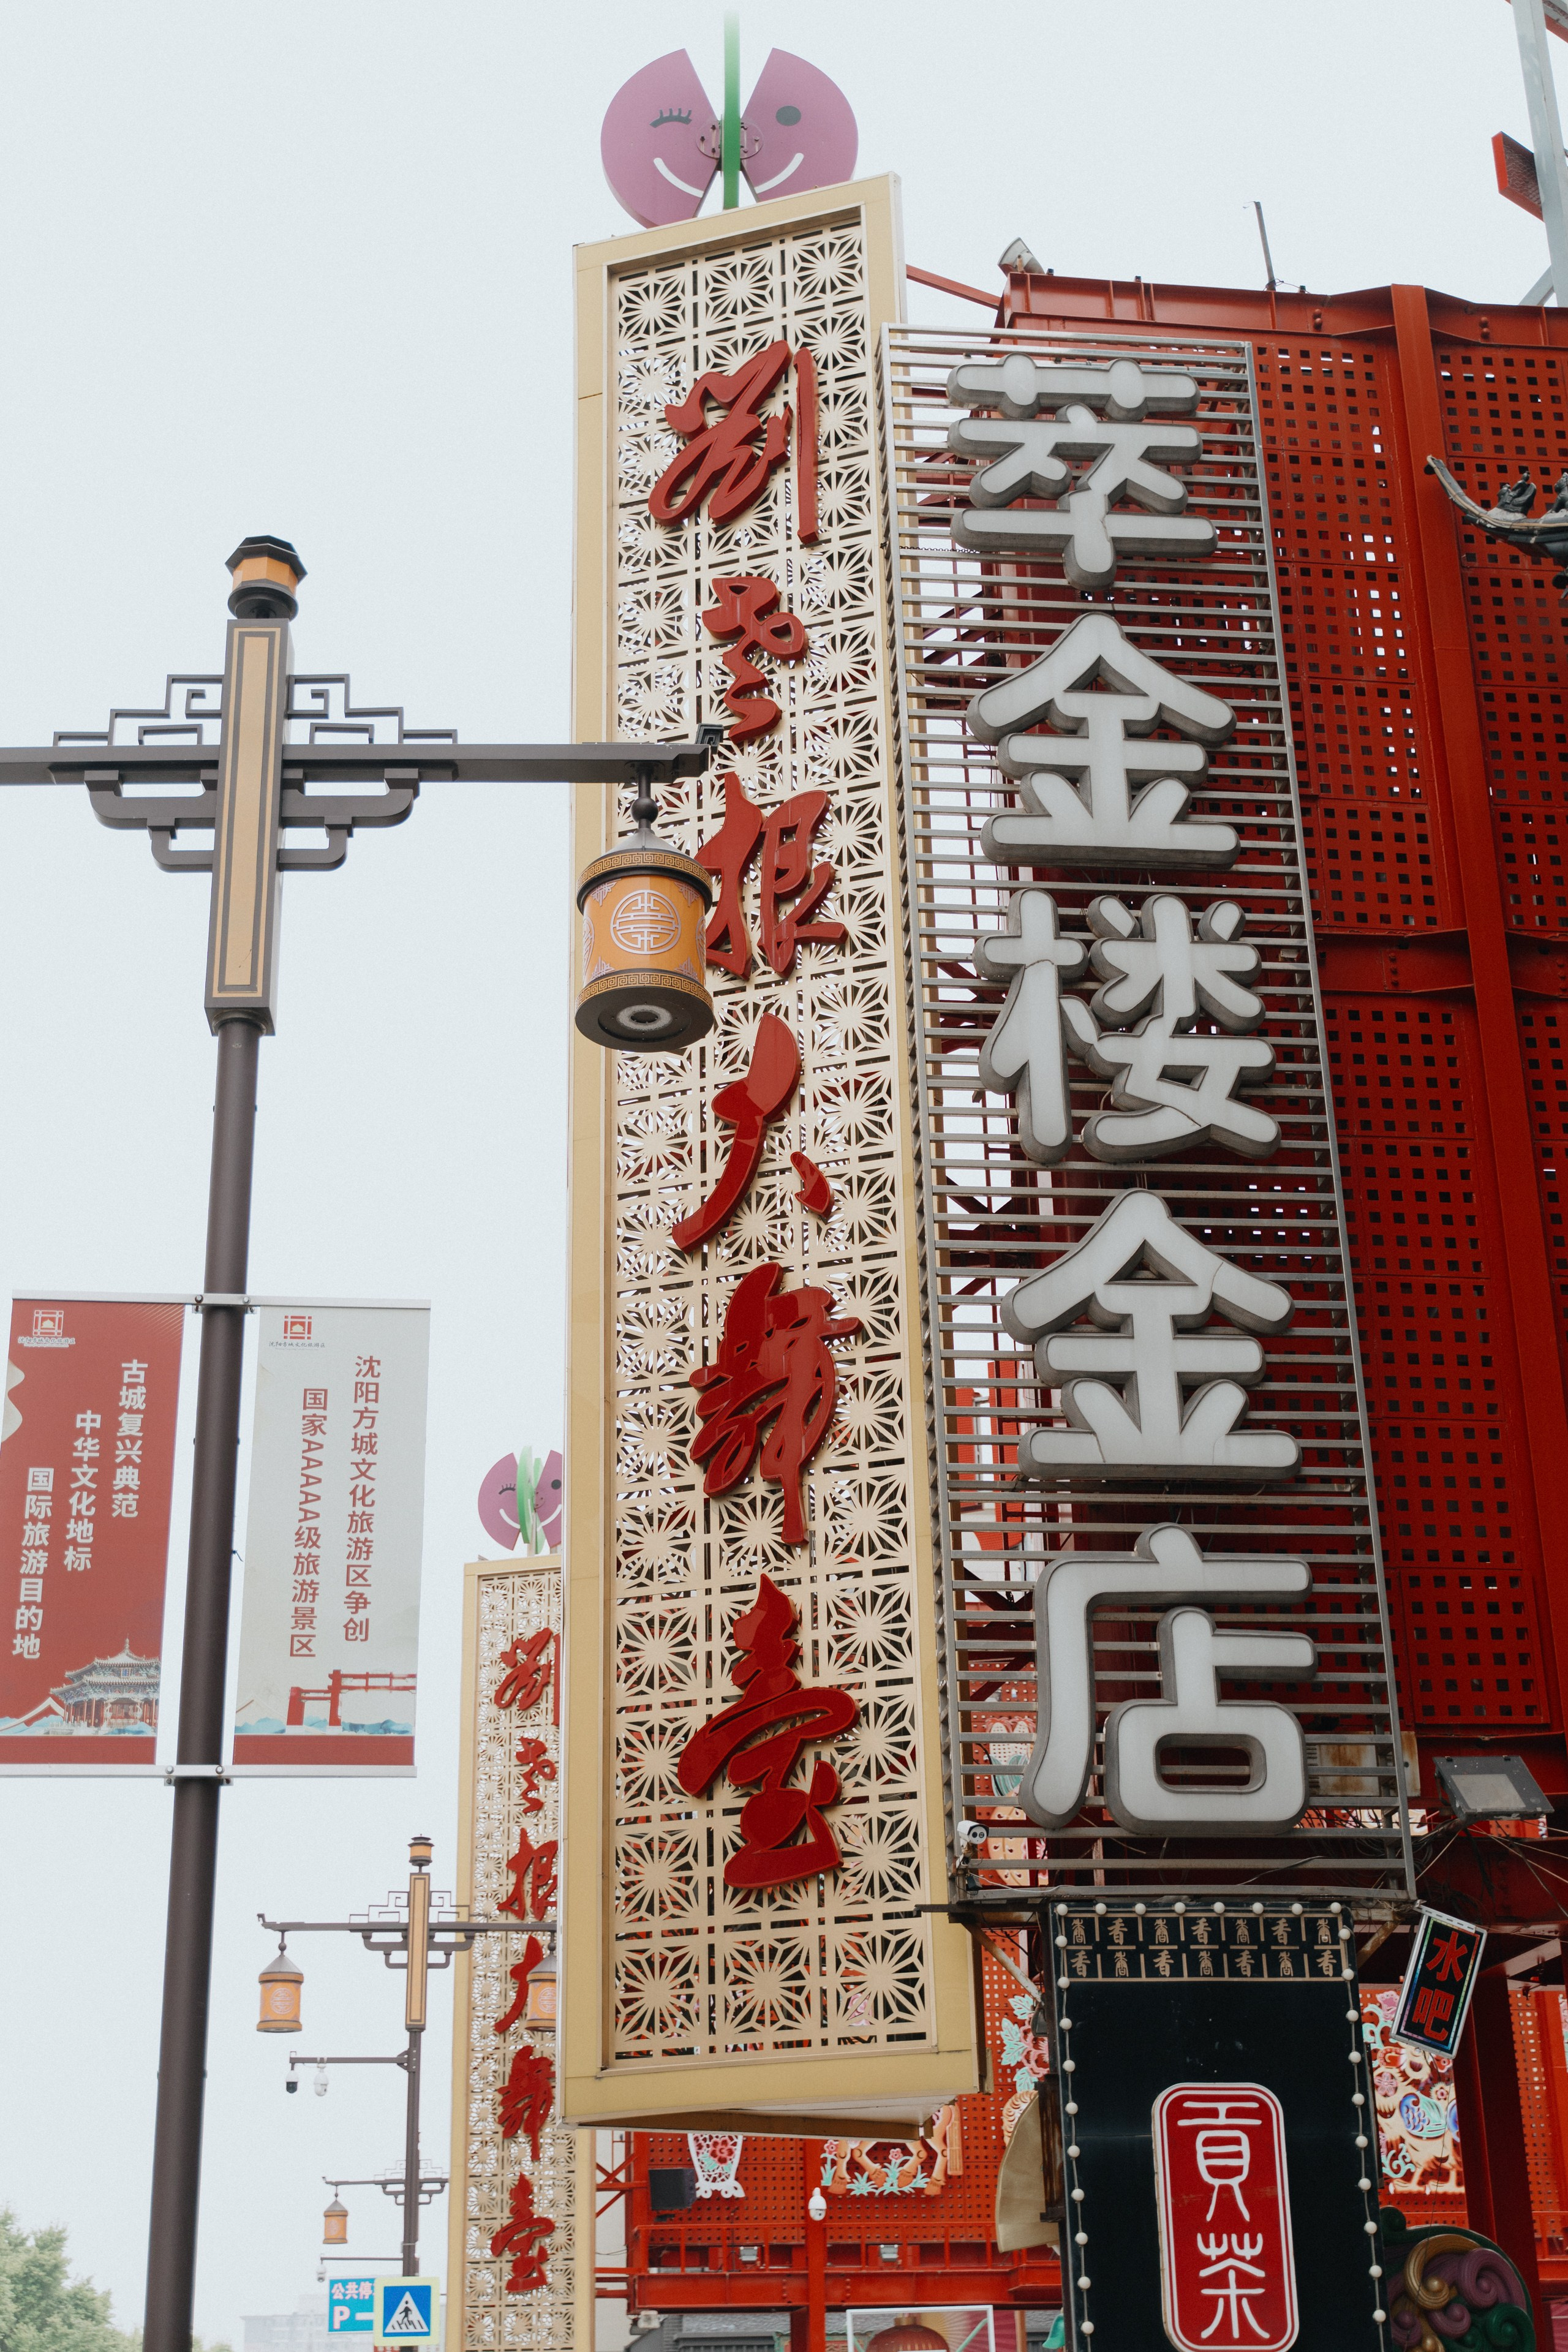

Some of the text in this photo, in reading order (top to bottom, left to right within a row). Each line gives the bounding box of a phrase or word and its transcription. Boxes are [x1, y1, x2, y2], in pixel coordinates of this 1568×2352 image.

[947, 352, 1317, 1835] 萃金楼金店
[64, 1409, 101, 1572] 中华文化地标
[111, 1359, 148, 1518] 古城复兴典范
[342, 1355, 382, 1643] 沈阳方城文化旅游区争创
[12, 1467, 54, 1660] 国际旅游目的地
[290, 1387, 328, 1658] 国家AAAAA级旅游景区
[1412, 1931, 1468, 2041] 水吧
[331, 2281, 375, 2300] 公共停
[333, 2305, 350, 2329] P
